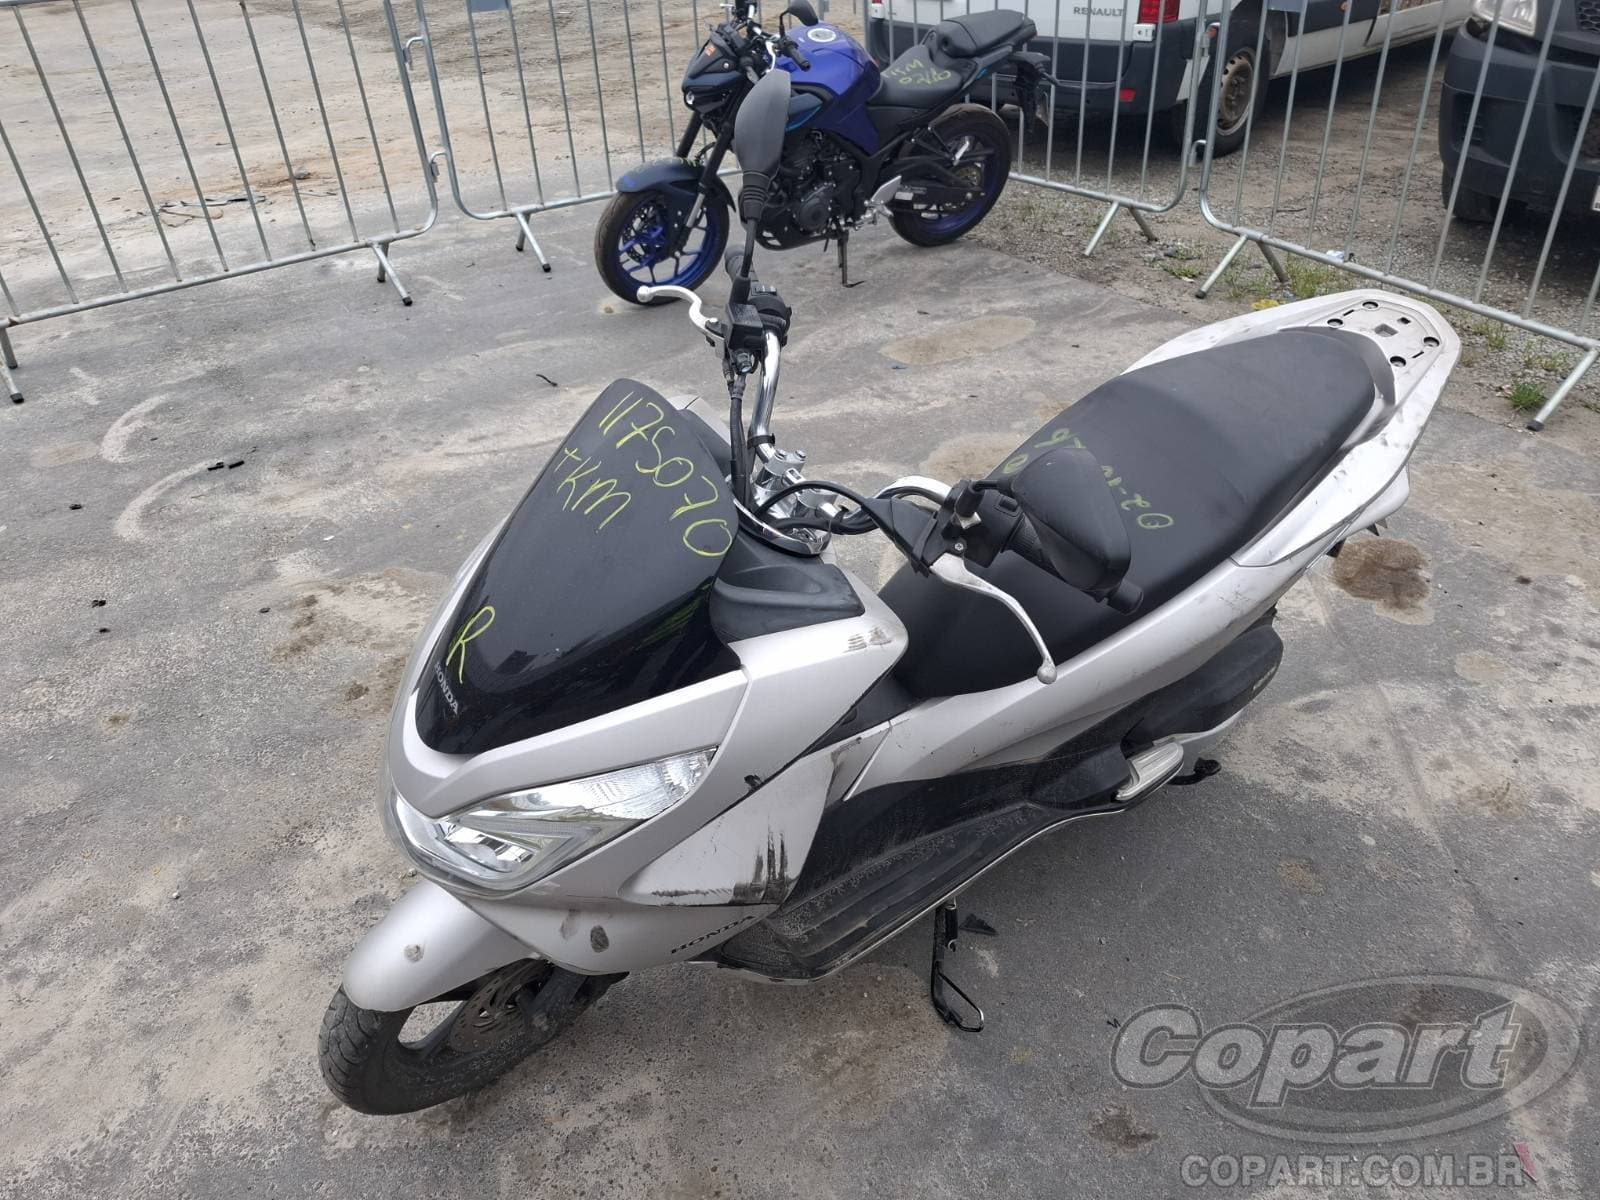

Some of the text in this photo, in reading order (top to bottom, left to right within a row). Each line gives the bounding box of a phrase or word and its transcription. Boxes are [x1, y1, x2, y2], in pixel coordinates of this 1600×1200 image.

[1073, 6, 1125, 17] RENAULT
[445, 605, 496, 685] R
[434, 661, 459, 715] HONDA
[671, 915, 757, 954] HONDA
